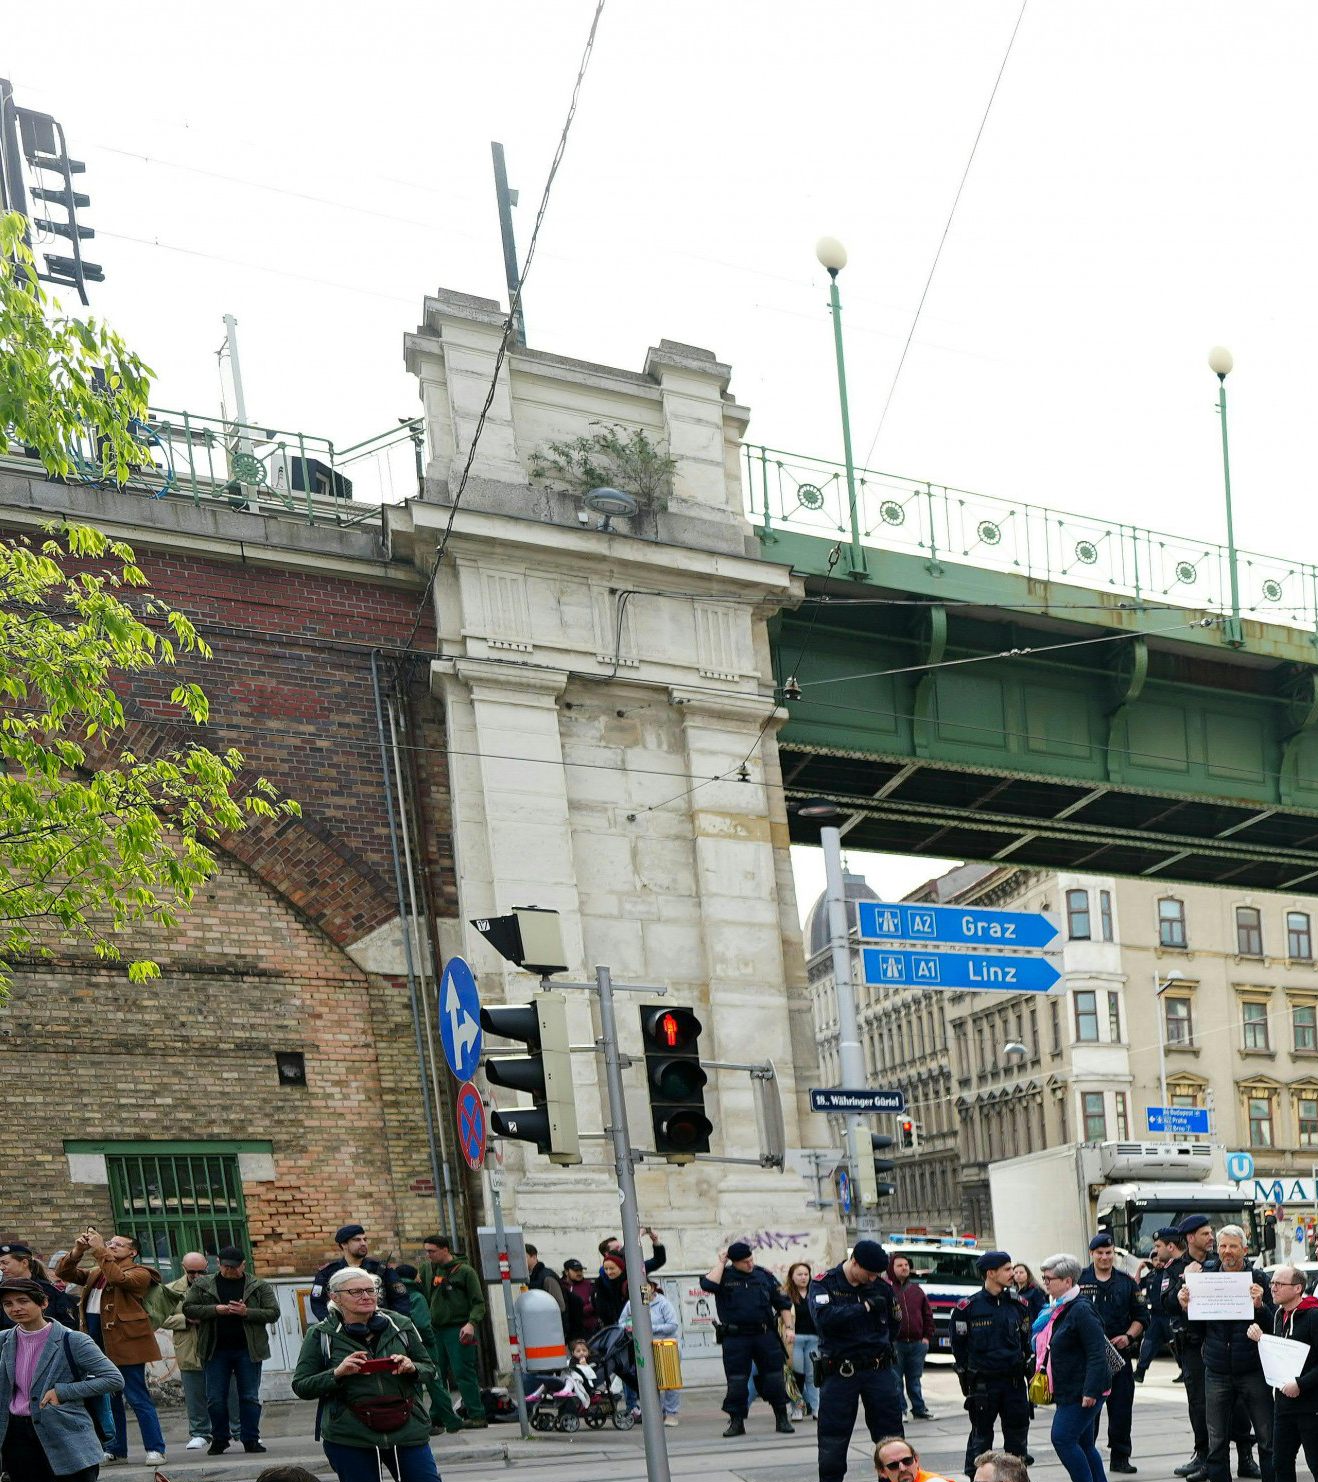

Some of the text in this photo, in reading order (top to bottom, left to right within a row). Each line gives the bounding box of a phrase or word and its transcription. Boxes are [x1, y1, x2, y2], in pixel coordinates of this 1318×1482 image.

[478, 920, 490, 931] 17
[914, 915, 1016, 939] A2 Graz
[918, 960, 1017, 983] A1 Linz
[831, 1095, 873, 1108] Währinger
[875, 1096, 899, 1107] Gürtel
[1231, 1158, 1250, 1178] U
